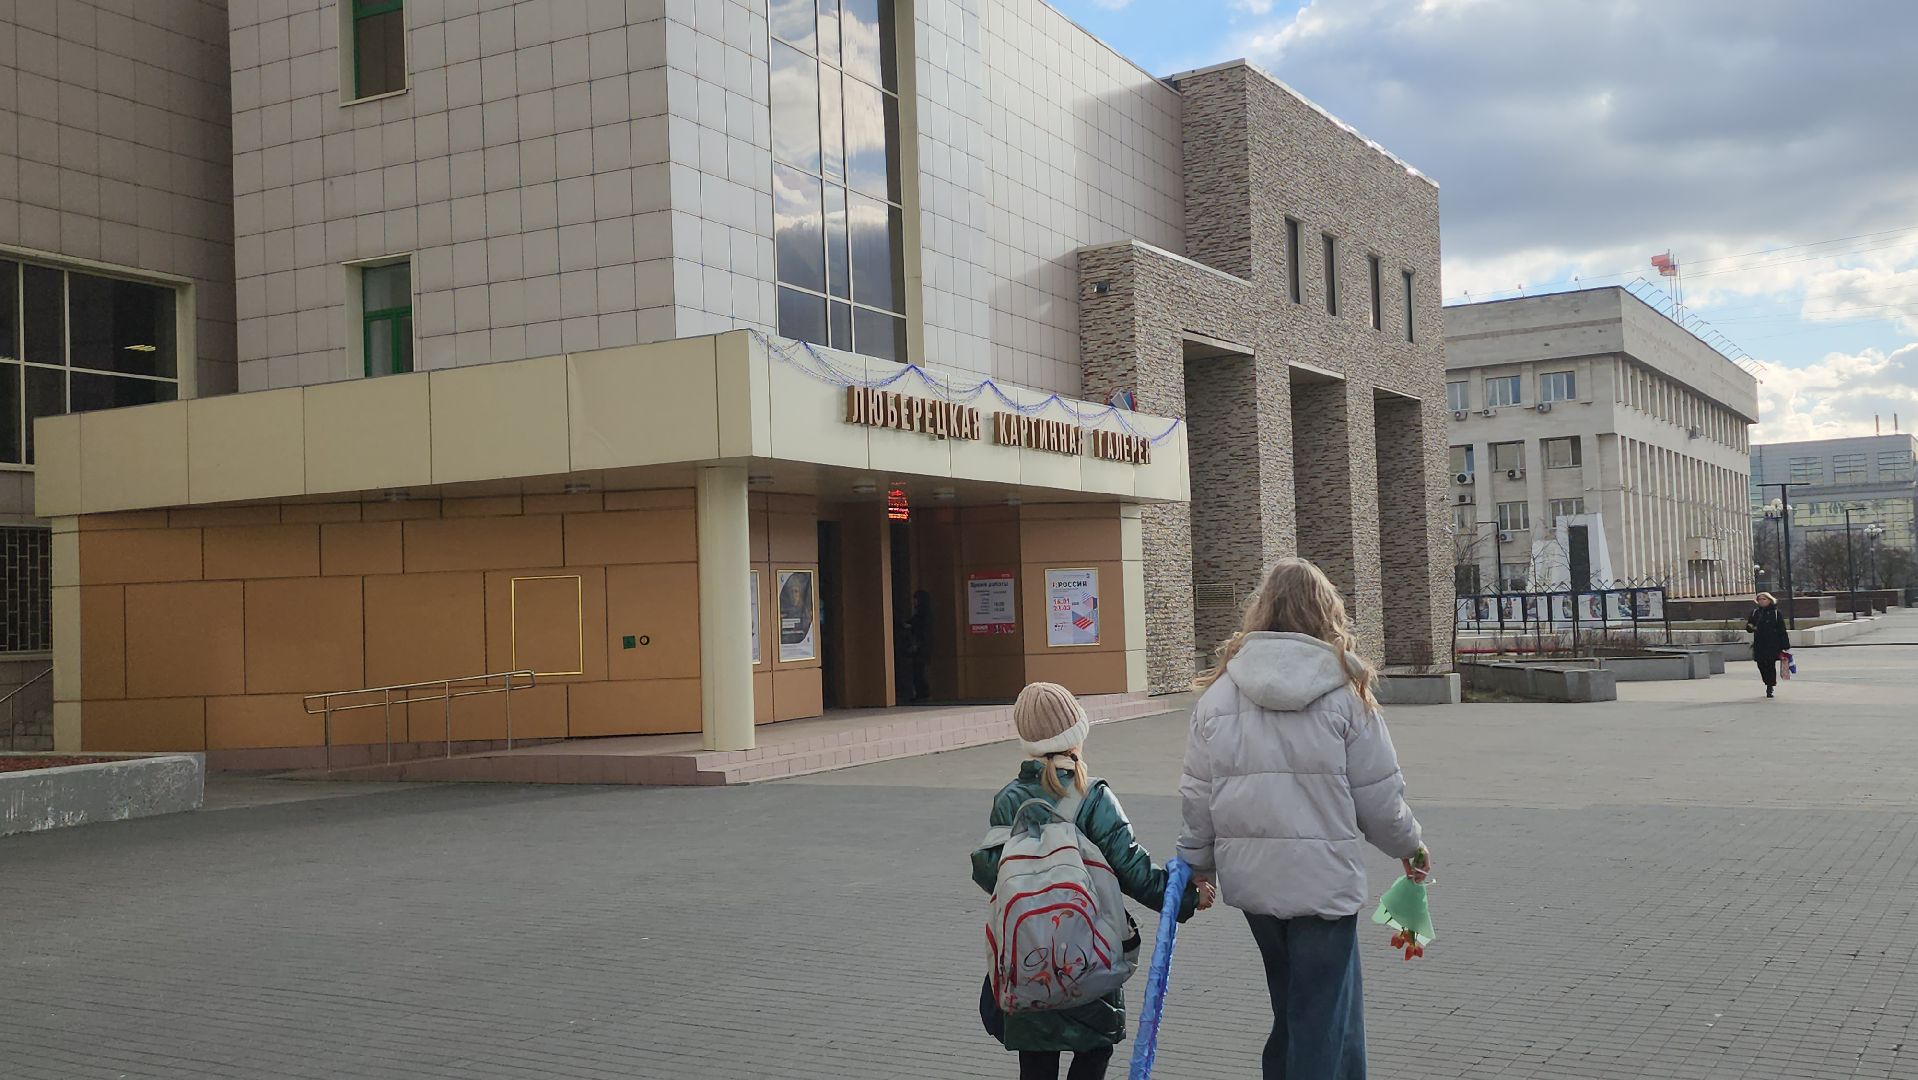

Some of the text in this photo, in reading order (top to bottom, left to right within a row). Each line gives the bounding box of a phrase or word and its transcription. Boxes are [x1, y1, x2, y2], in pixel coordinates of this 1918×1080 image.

[848, 385, 1151, 464] ЛЮБЕРЕЦКАЯ КАРТИННАЯ ГАЛЕРЕЯ
